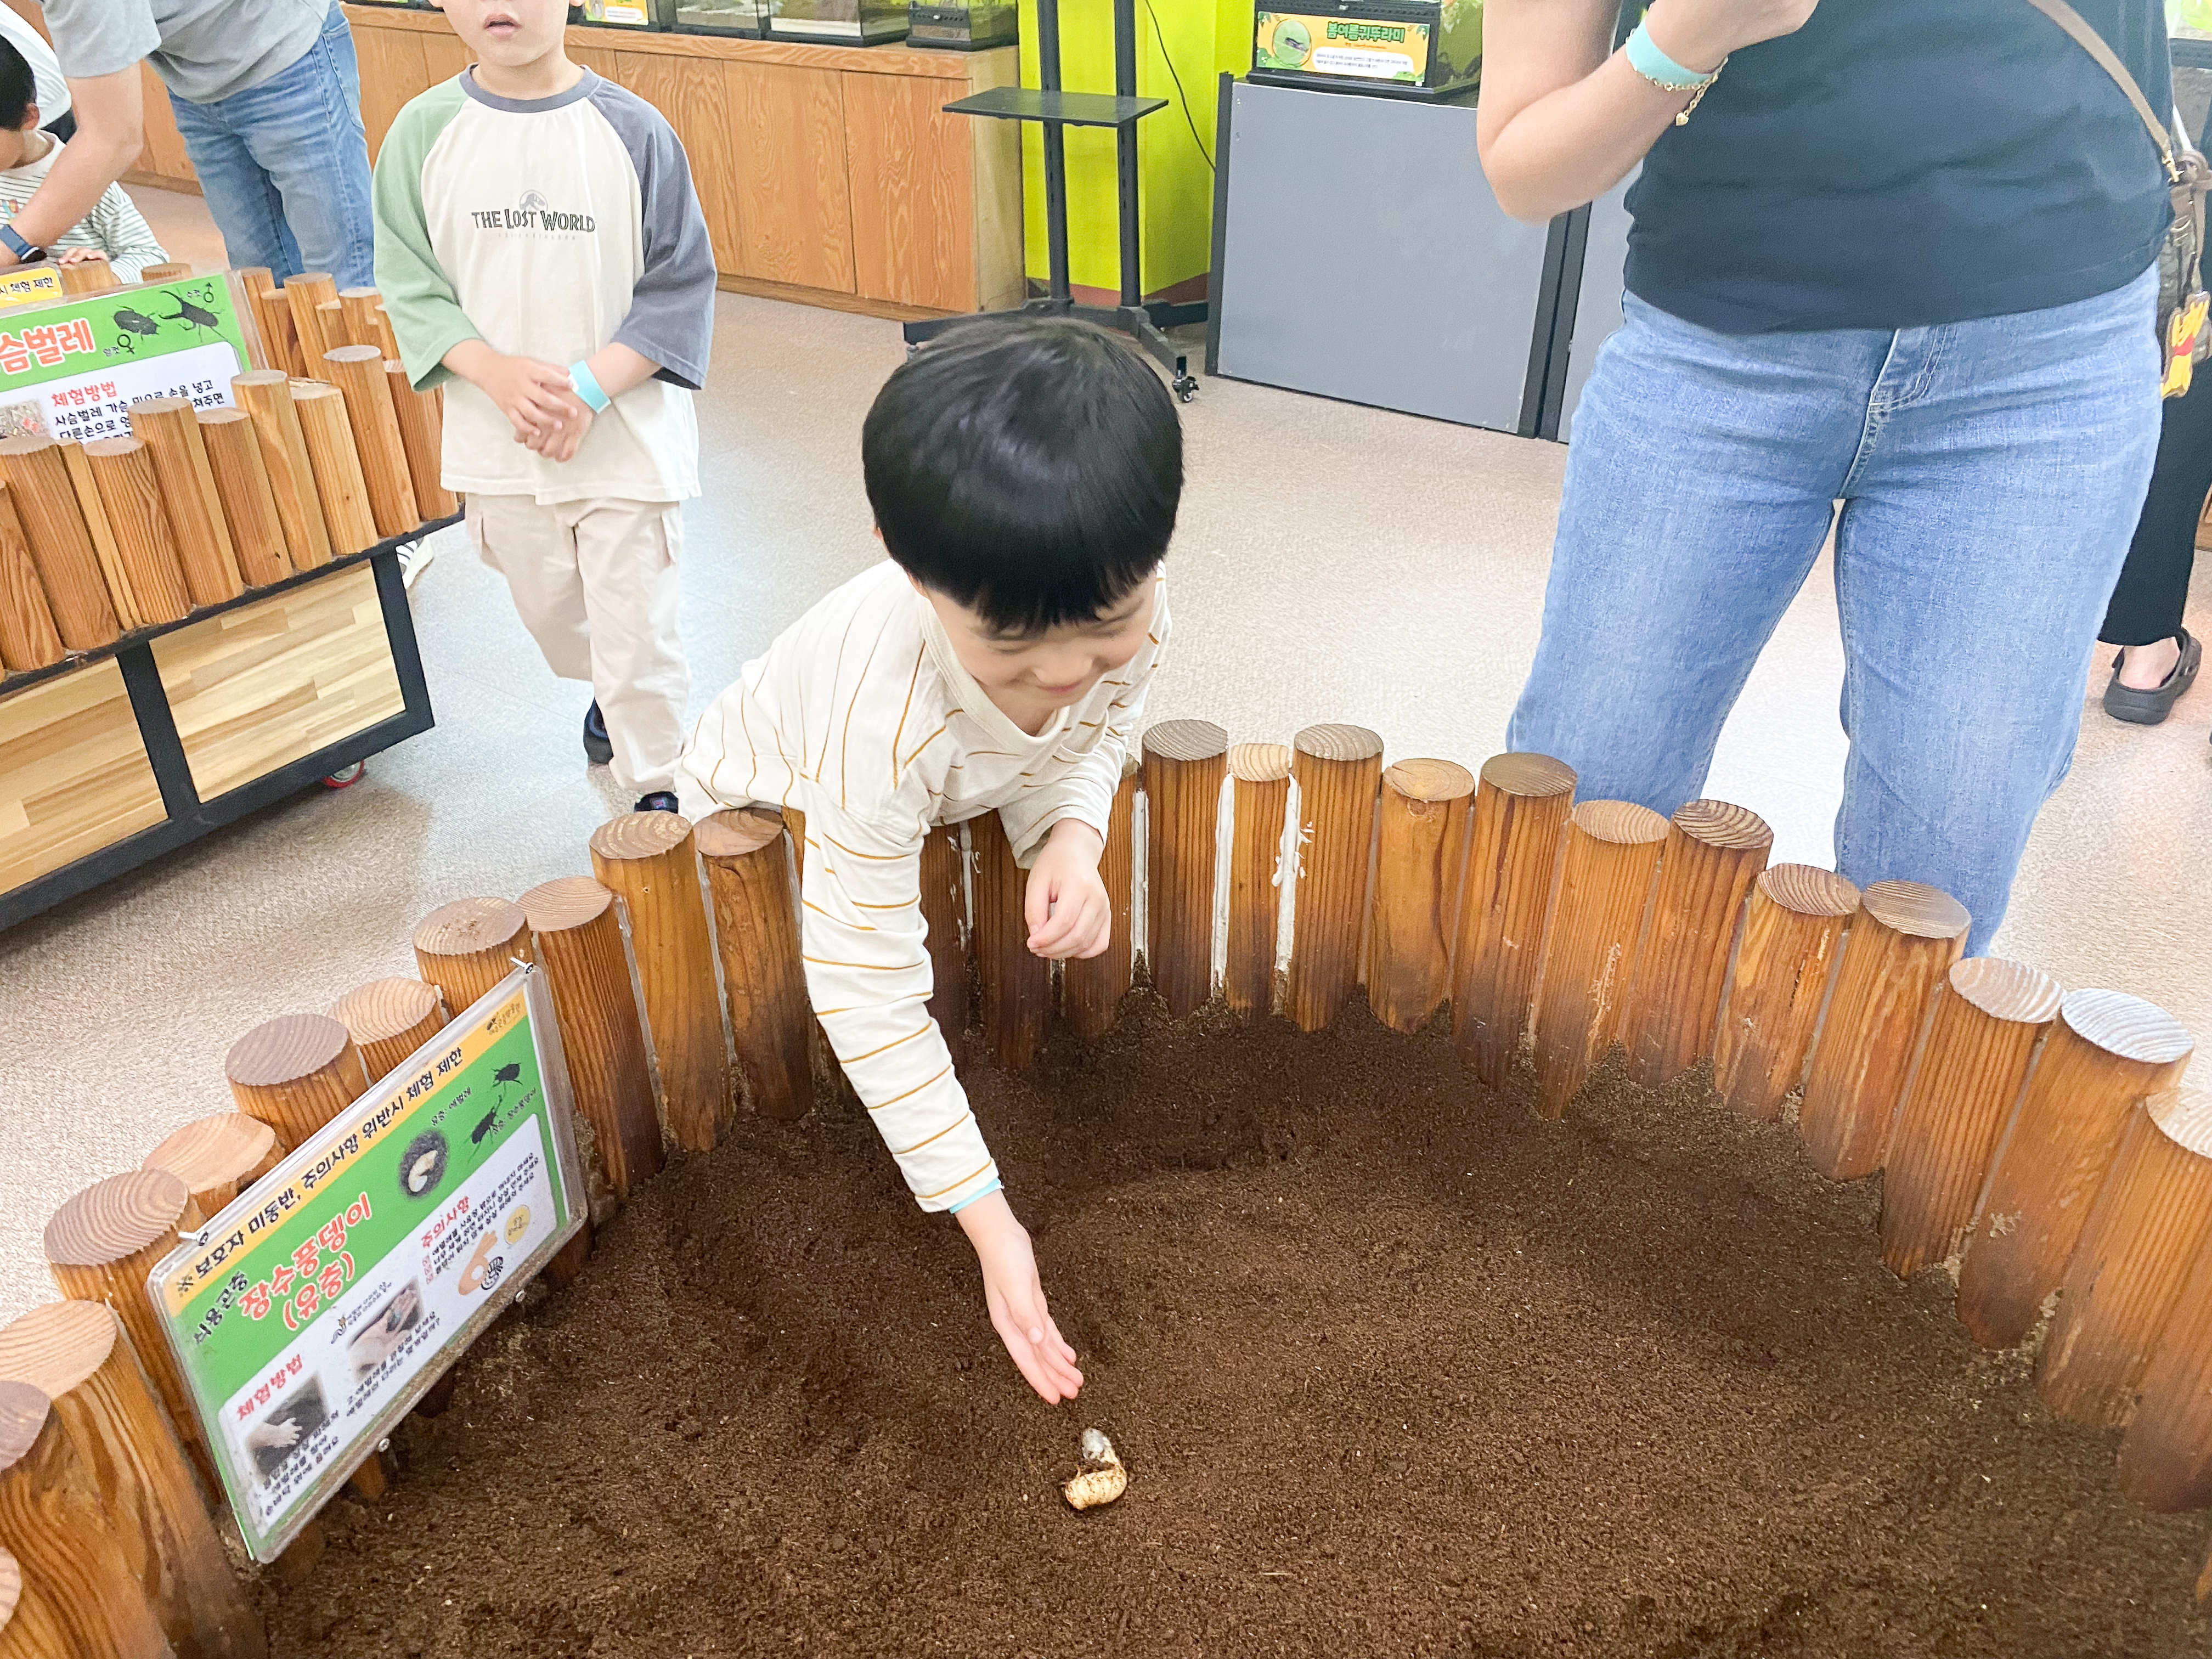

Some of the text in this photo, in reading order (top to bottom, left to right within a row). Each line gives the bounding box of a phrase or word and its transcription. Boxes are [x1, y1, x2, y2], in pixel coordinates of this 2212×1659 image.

[1327, 21, 1406, 43] 봄여름귀뚜라미
[471, 208, 595, 232] THE LOST WORLD
[10, 280, 31, 292] 체험
[33, 276, 53, 288] 제한
[51, 381, 117, 407] 체험방법
[55, 407, 103, 426] 사슴벌레
[105, 400, 127, 413] 가슴
[195, 1229, 246, 1279] 보호자
[247, 1185, 301, 1238] 미동반,
[301, 1133, 359, 1192] 주의사항
[362, 1096, 404, 1141] 위반시
[405, 1070, 434, 1103] 체험
[436, 1047, 463, 1079] 제한
[421, 1195, 470, 1248] 주의사항
[238, 1192, 373, 1320] 장수풍뎅이
[194, 1269, 249, 1344] 식용곤충
[283, 1254, 356, 1331] (유충)
[236, 1355, 304, 1421] 체험방법
